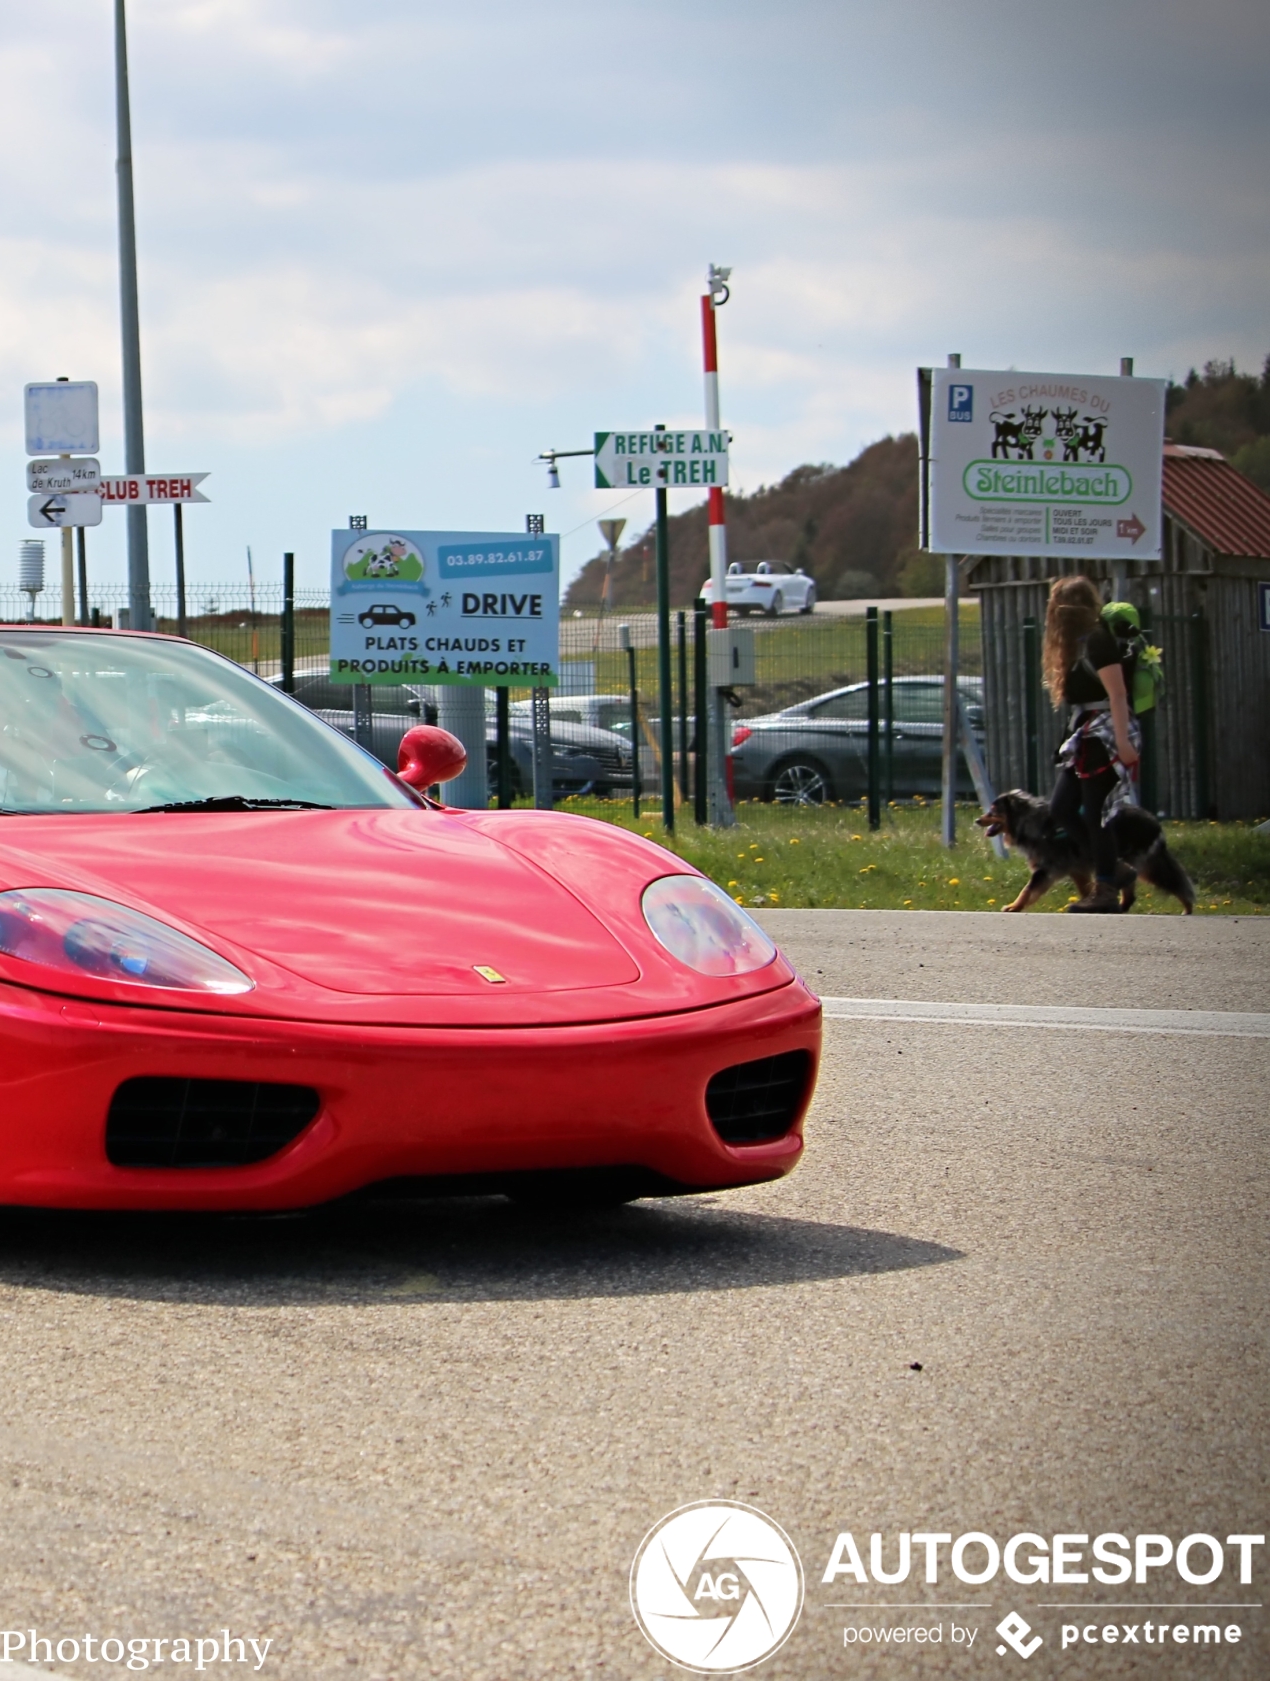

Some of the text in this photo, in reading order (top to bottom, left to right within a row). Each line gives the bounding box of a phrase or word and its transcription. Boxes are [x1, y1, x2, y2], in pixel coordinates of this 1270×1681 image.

[953, 387, 969, 409] P
[990, 384, 1111, 413] LES CHAUMES DU
[949, 411, 971, 421] BUS
[615, 433, 726, 454] REFUGE A.N.
[32, 463, 48, 474] Lac
[627, 460, 716, 484] Le TREH
[32, 478, 71, 489] de Kruth
[95, 479, 192, 500] CLUB TREH
[976, 467, 1119, 497] Steinlebach
[1052, 509, 1082, 517] OUVERT
[1074, 518, 1087, 526] LES
[1089, 518, 1112, 526] JOURS
[1052, 527, 1098, 535] MIDI ET SOIR
[1126, 526, 1138, 535] km
[447, 551, 544, 567] 03.89.82.61.87
[462, 593, 542, 616] DRIVE
[365, 637, 526, 652] PLATS CHAUDS ET
[338, 657, 550, 676] PRODUITS À EMPORTER
